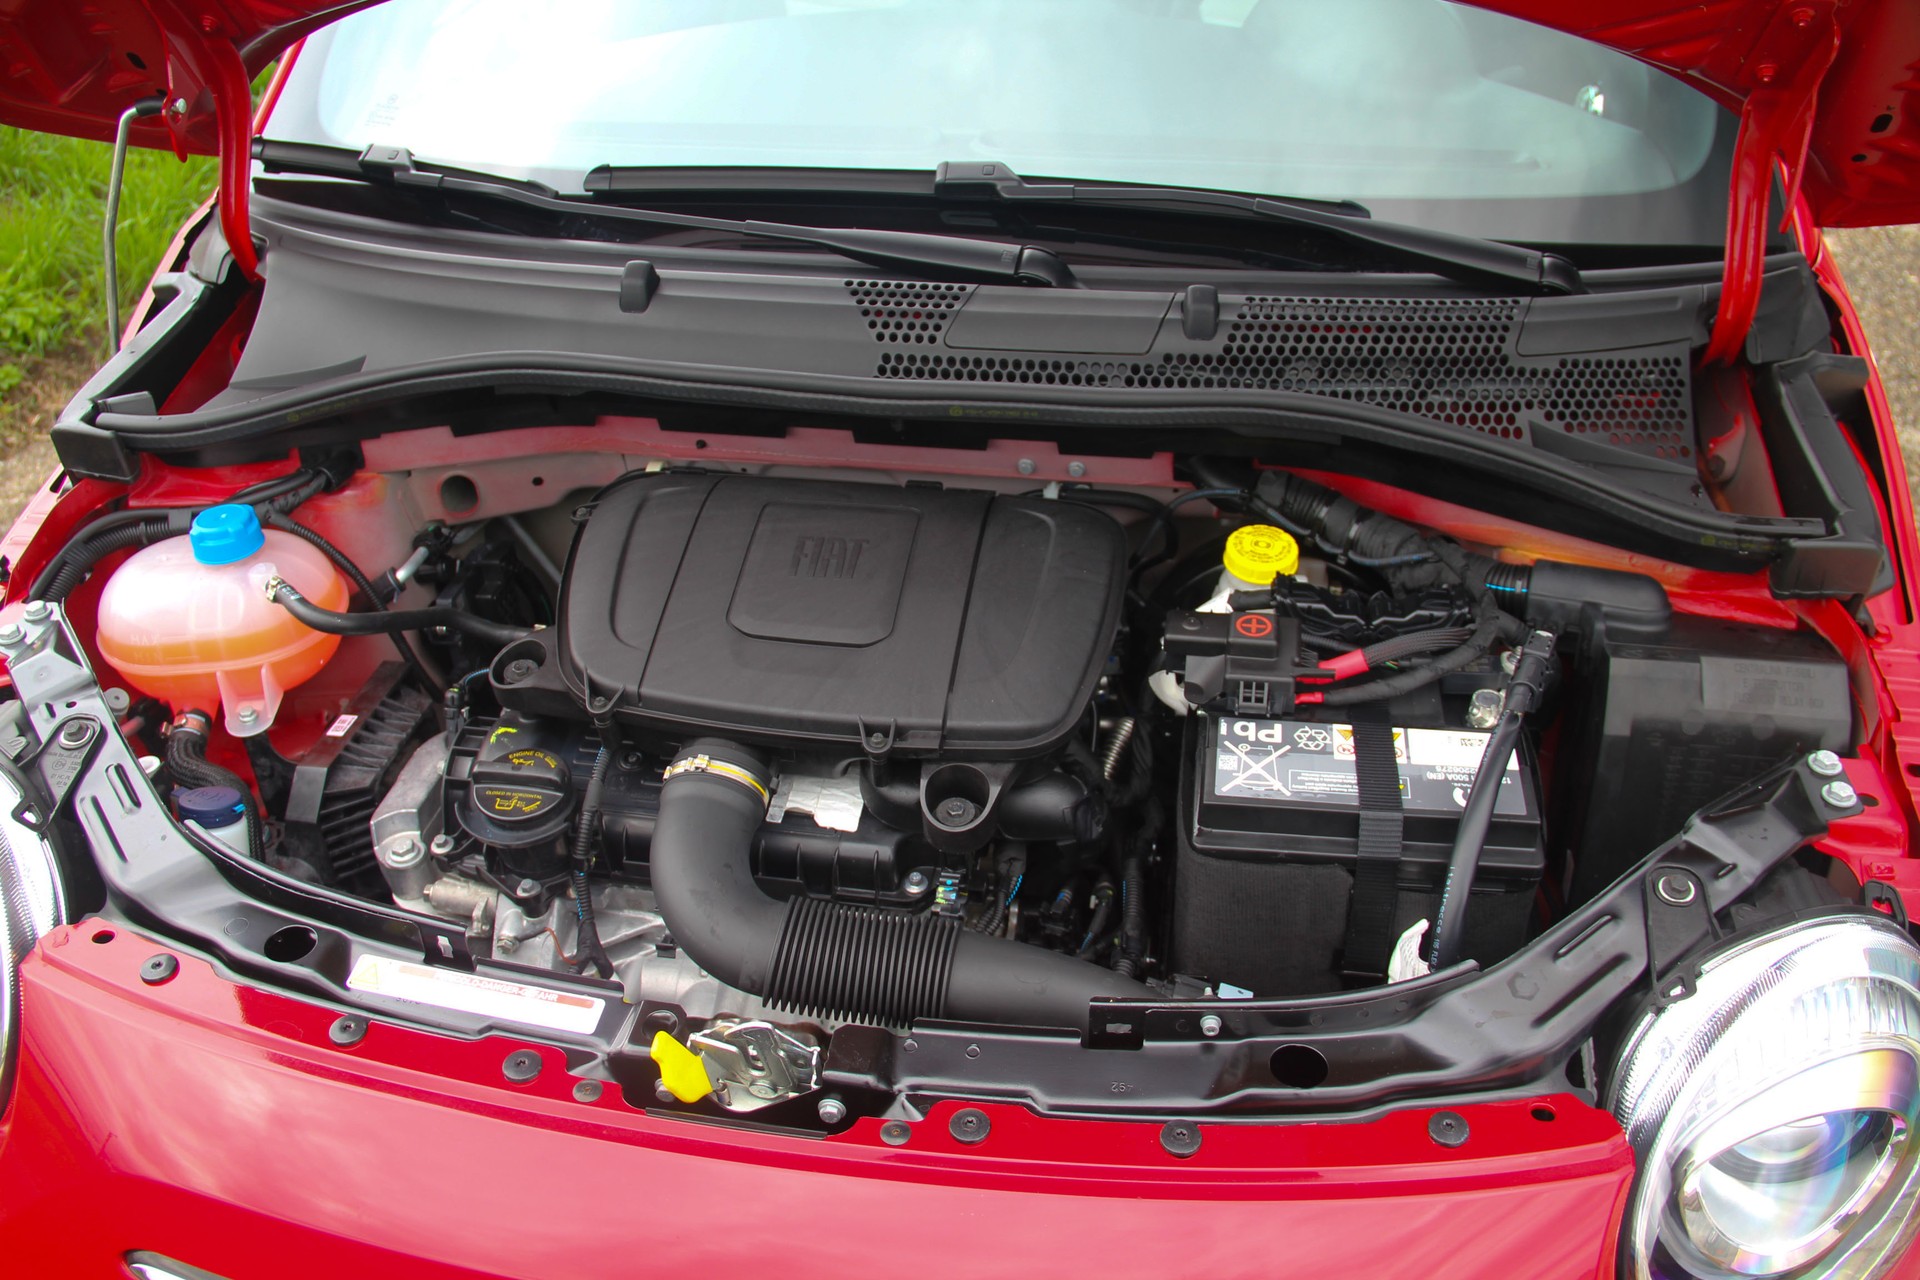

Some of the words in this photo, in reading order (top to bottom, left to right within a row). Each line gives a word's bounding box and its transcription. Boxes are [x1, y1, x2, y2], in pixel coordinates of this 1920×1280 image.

[790, 536, 869, 578] FIAT
[130, 632, 160, 646] MAX
[1233, 721, 1283, 744] Pb
[509, 750, 535, 760] ENGINE
[535, 751, 545, 759] OIL
